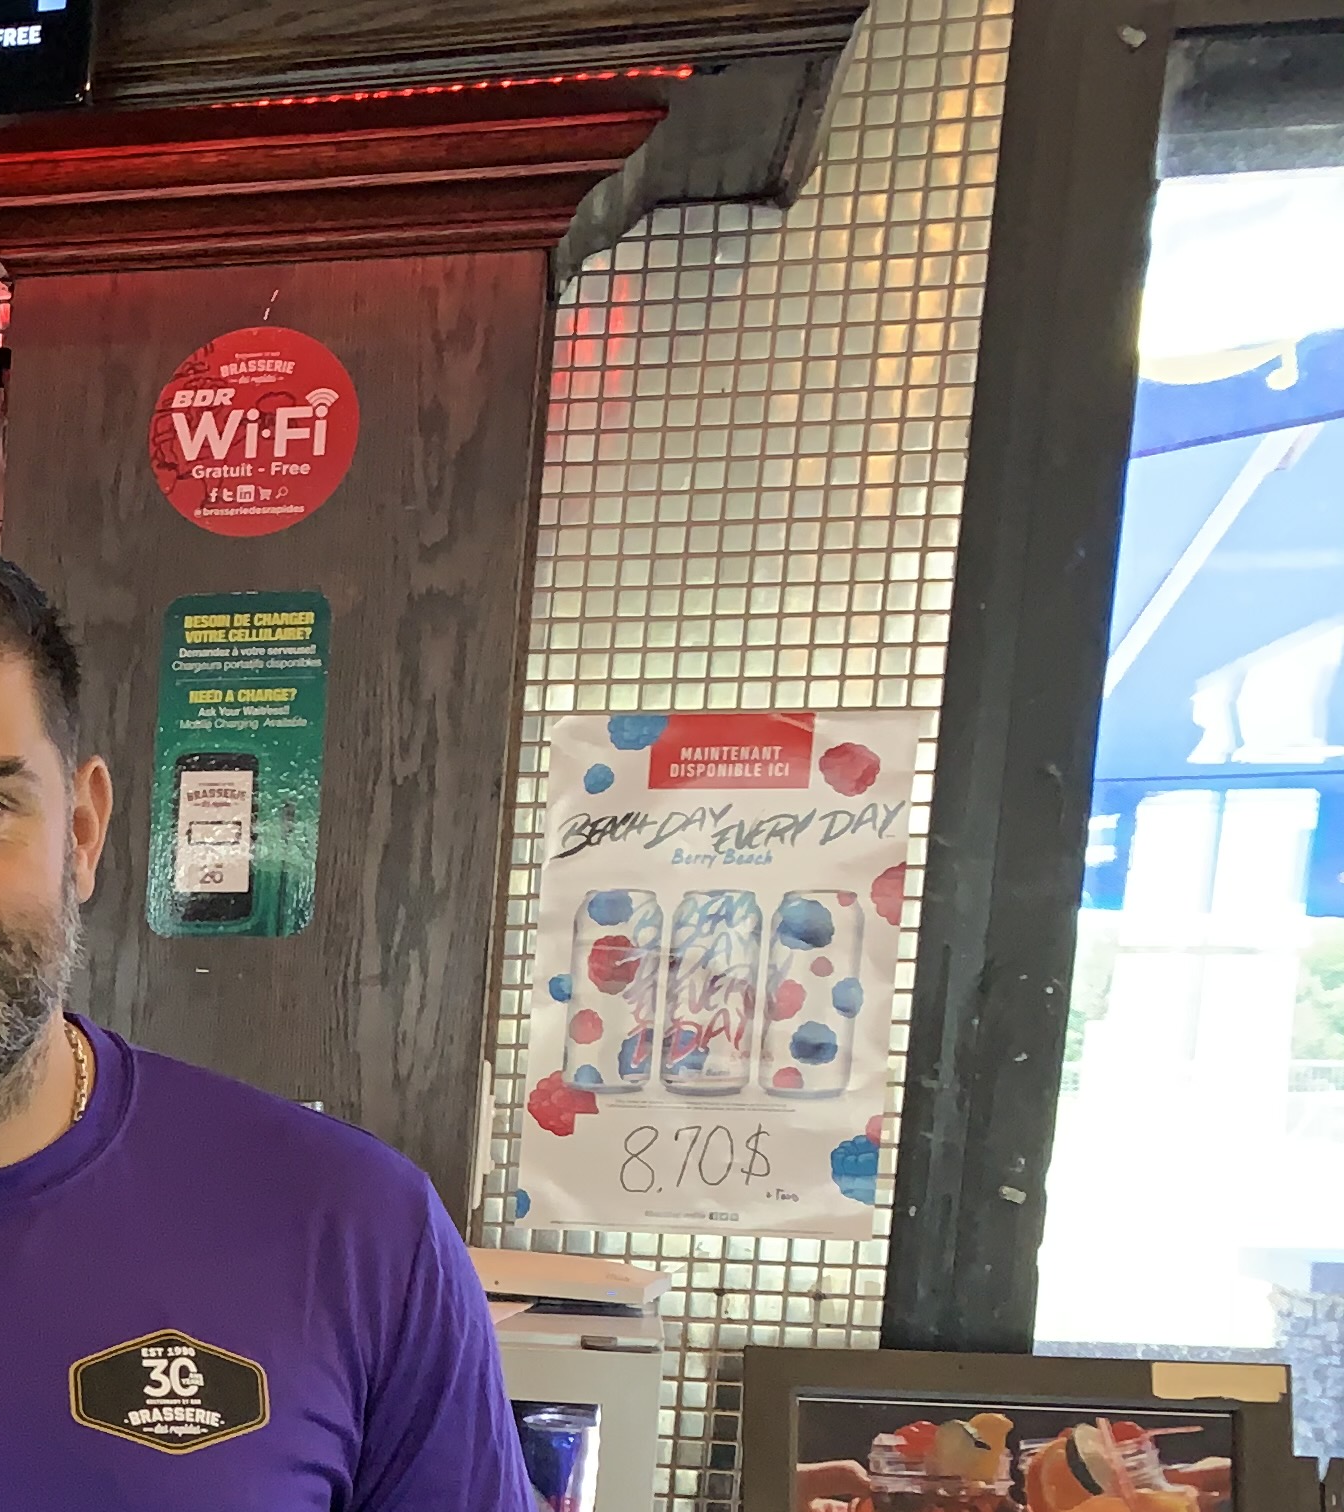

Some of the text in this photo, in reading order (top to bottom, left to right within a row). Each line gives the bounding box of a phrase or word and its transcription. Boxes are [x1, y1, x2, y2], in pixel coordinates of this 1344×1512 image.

[219, 359, 296, 377] BRASSERIE
[170, 388, 236, 408] BDR
[191, 463, 253, 479] Gratuit
[270, 461, 311, 476] Free
[234, 614, 250, 627] DE
[253, 612, 315, 626] CHARGER
[185, 629, 226, 643] VOTRE
[188, 688, 297, 704] NEED A CHARGE?
[198, 706, 216, 717] Ask
[218, 706, 241, 716] Your
[680, 746, 784, 761] MAINTENANT
[669, 762, 790, 778] DISPONIBLE ICI
[186, 788, 247, 802] BRASSERIE
[550, 800, 906, 860] BEACH DAY EVERY DAY
[671, 849, 774, 868] Berry Beach
[141, 1346, 196, 1357] EST 1990
[142, 1357, 199, 1397] 30
[127, 1406, 222, 1427] BRASSERIE
